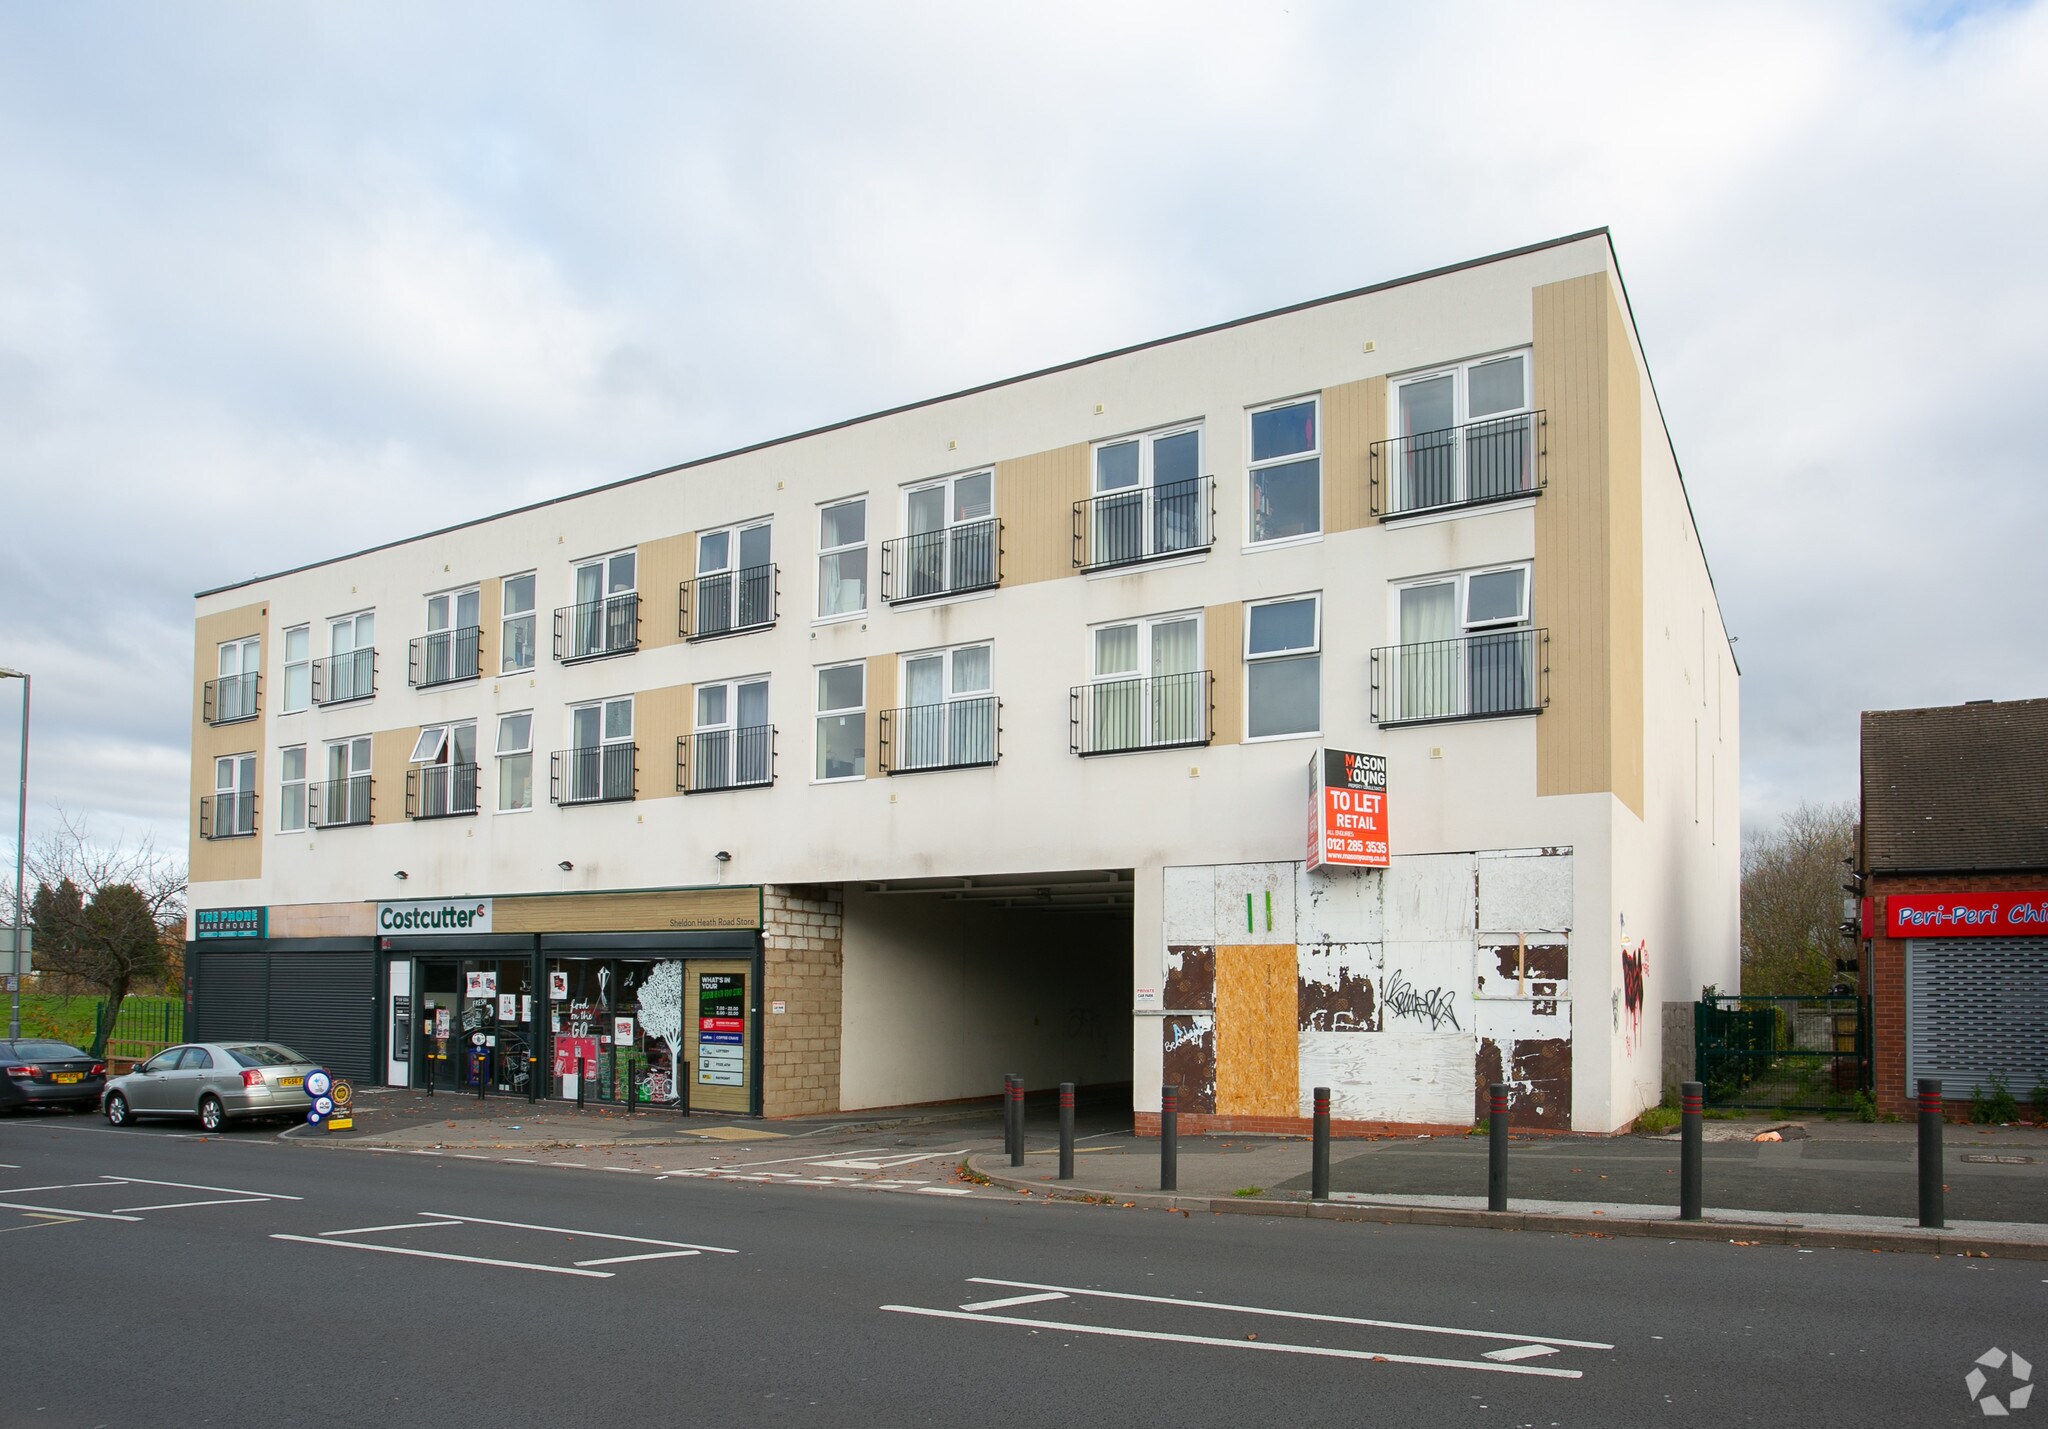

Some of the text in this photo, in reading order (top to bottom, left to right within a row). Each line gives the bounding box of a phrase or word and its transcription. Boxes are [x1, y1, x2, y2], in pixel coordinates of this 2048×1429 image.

[1344, 753, 1385, 772] MASON
[1345, 768, 1386, 787] YOUNG
[1330, 790, 1382, 814] TO LET
[1336, 813, 1377, 831] RETAIL
[1327, 837, 1387, 854] 0121 285 3535
[1327, 852, 1388, 863] www.masonyoung.co.uk
[199, 909, 258, 923] THE PHONE
[380, 906, 476, 930] Costcutter
[669, 917, 755, 928] Sheldon Heath Road Store
[1898, 903, 1999, 926] Peri-Peri
[199, 921, 258, 930] WAREHOUSE
[472, 999, 487, 1007] FRESH
[570, 998, 590, 1014] food
[580, 1010, 593, 1020] the
[571, 1021, 588, 1038] GO
